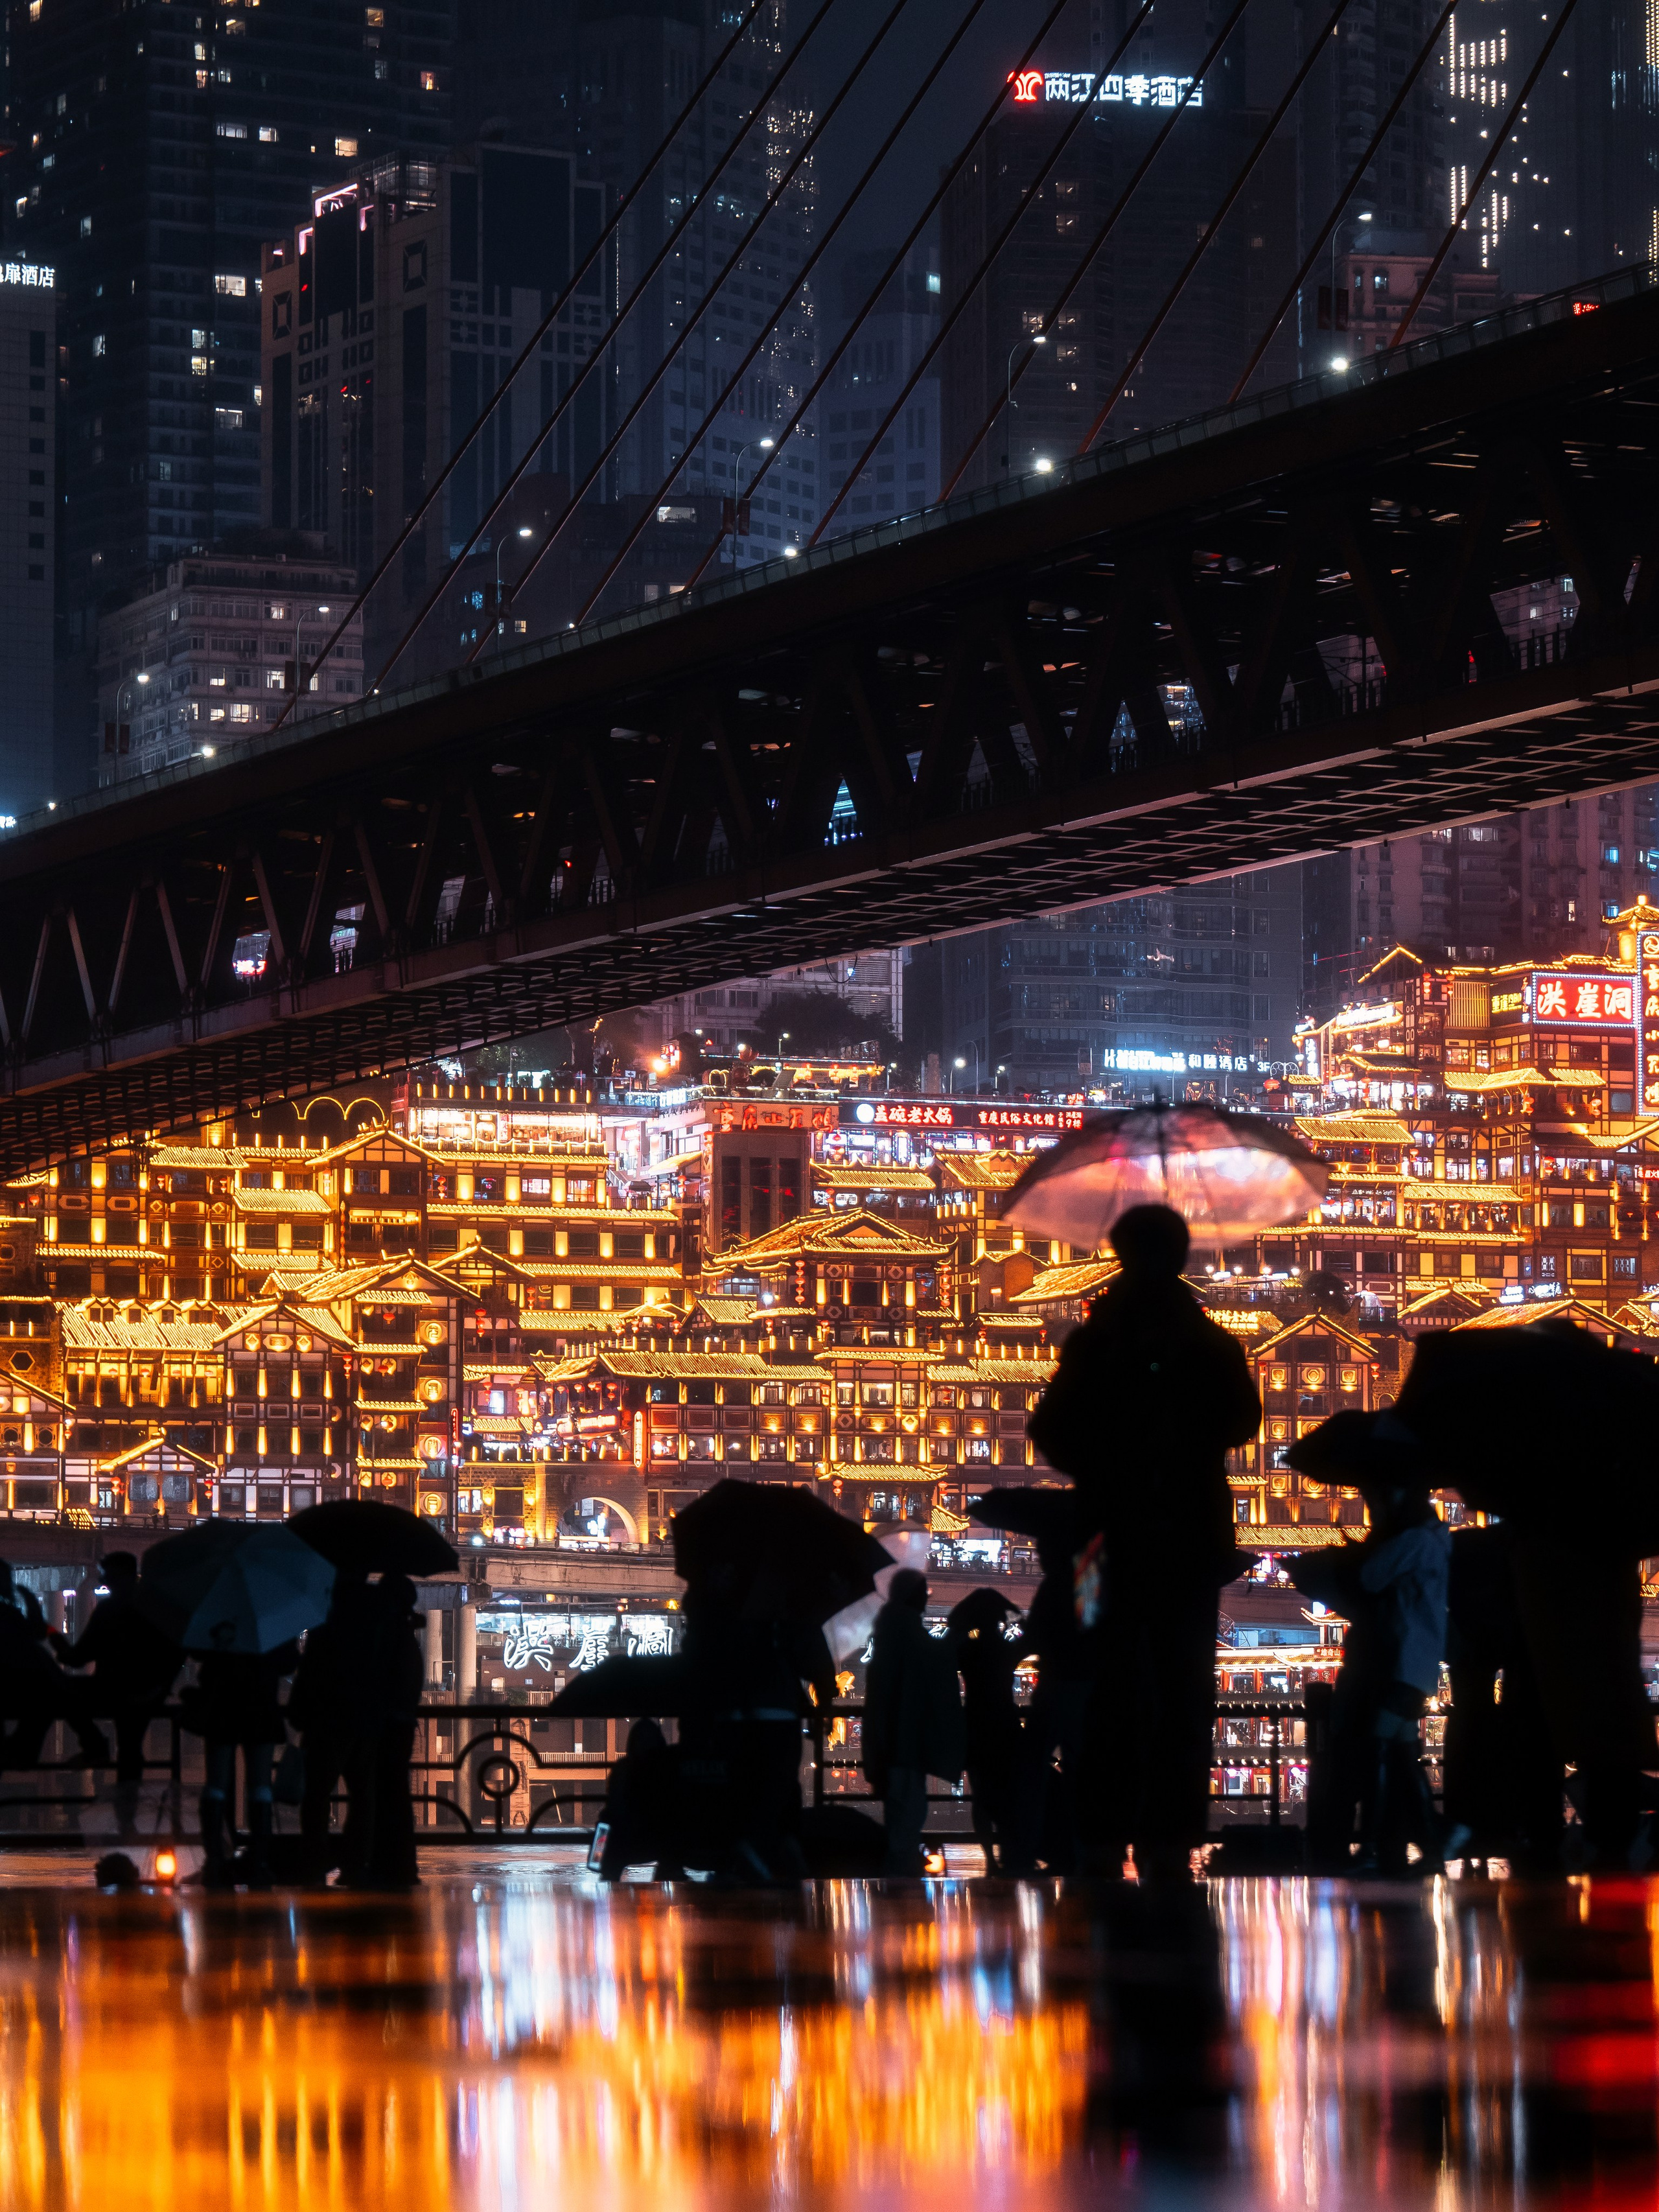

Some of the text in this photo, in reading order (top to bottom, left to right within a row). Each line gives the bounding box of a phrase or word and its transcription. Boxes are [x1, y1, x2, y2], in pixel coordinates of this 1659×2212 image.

[1044, 72, 1203, 107] 两江四季酒店
[0, 262, 56, 288] 扉酒店
[1537, 980, 1632, 1020] 洪崖洞
[1257, 1062, 1270, 1073] 3F
[874, 1104, 953, 1125] 盖碗老火锅
[504, 1617, 673, 1671] 洪崖洞
